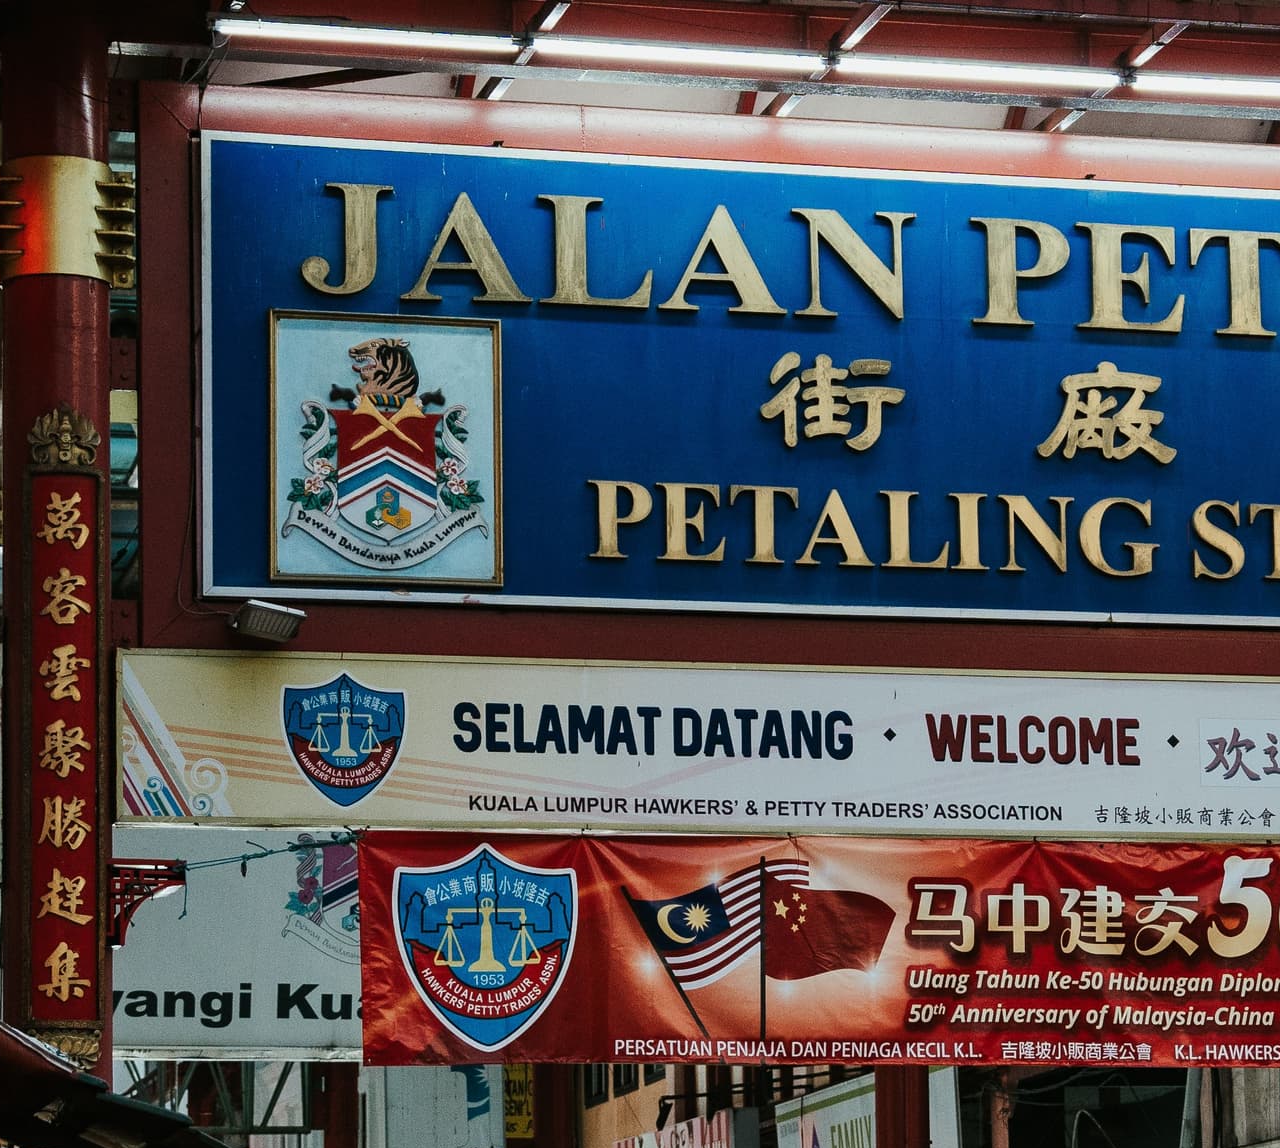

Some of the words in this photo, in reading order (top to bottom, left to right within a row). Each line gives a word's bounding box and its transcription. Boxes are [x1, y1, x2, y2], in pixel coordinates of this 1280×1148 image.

[300, 181, 917, 320] JALAN
[296, 509, 337, 540] Dewan
[338, 536, 401, 565] Bandaraya
[404, 540, 436, 559] Kuala
[435, 510, 478, 542] Lumpur
[588, 479, 1160, 578] PETALING
[452, 701, 662, 757] SELAMAT
[673, 706, 854, 762] DATANG
[925, 712, 1141, 766] WELCOME
[315, 759, 342, 778] KUALA
[344, 761, 377, 778] LUMPUR
[335, 757, 358, 767] 1953
[330, 777, 354, 787] PETTY
[468, 794, 538, 812] KUALA
[542, 796, 629, 815] LUMPUR
[746, 799, 759, 817] &
[764, 800, 827, 817] PETTY
[932, 803, 1063, 822] ASSOCIATION
[445, 977, 484, 1004] KUALA
[487, 976, 535, 1004] LUMPUR
[472, 971, 506, 987] 1953
[908, 969, 970, 996] Ulang
[976, 970, 1040, 990] Tahun
[1045, 972, 1104, 991] Ke-50
[1108, 971, 1214, 996] Hubungan
[275, 983, 363, 1021] Ku
[467, 999, 502, 1016] PETTY
[908, 1003, 947, 1024] 50th
[951, 1004, 1079, 1030] Anniversary
[1086, 1004, 1112, 1029] of
[1113, 1005, 1275, 1031] Malaysia-China
[615, 1038, 712, 1056] PERSATUAN
[717, 1040, 786, 1058] PENJAJA
[791, 1042, 827, 1058] DAN
[831, 1042, 903, 1059] PENIAGA
[906, 1042, 950, 1059] KECIL
[954, 1043, 983, 1059] K.L.
[1175, 1044, 1202, 1060] K.L.
